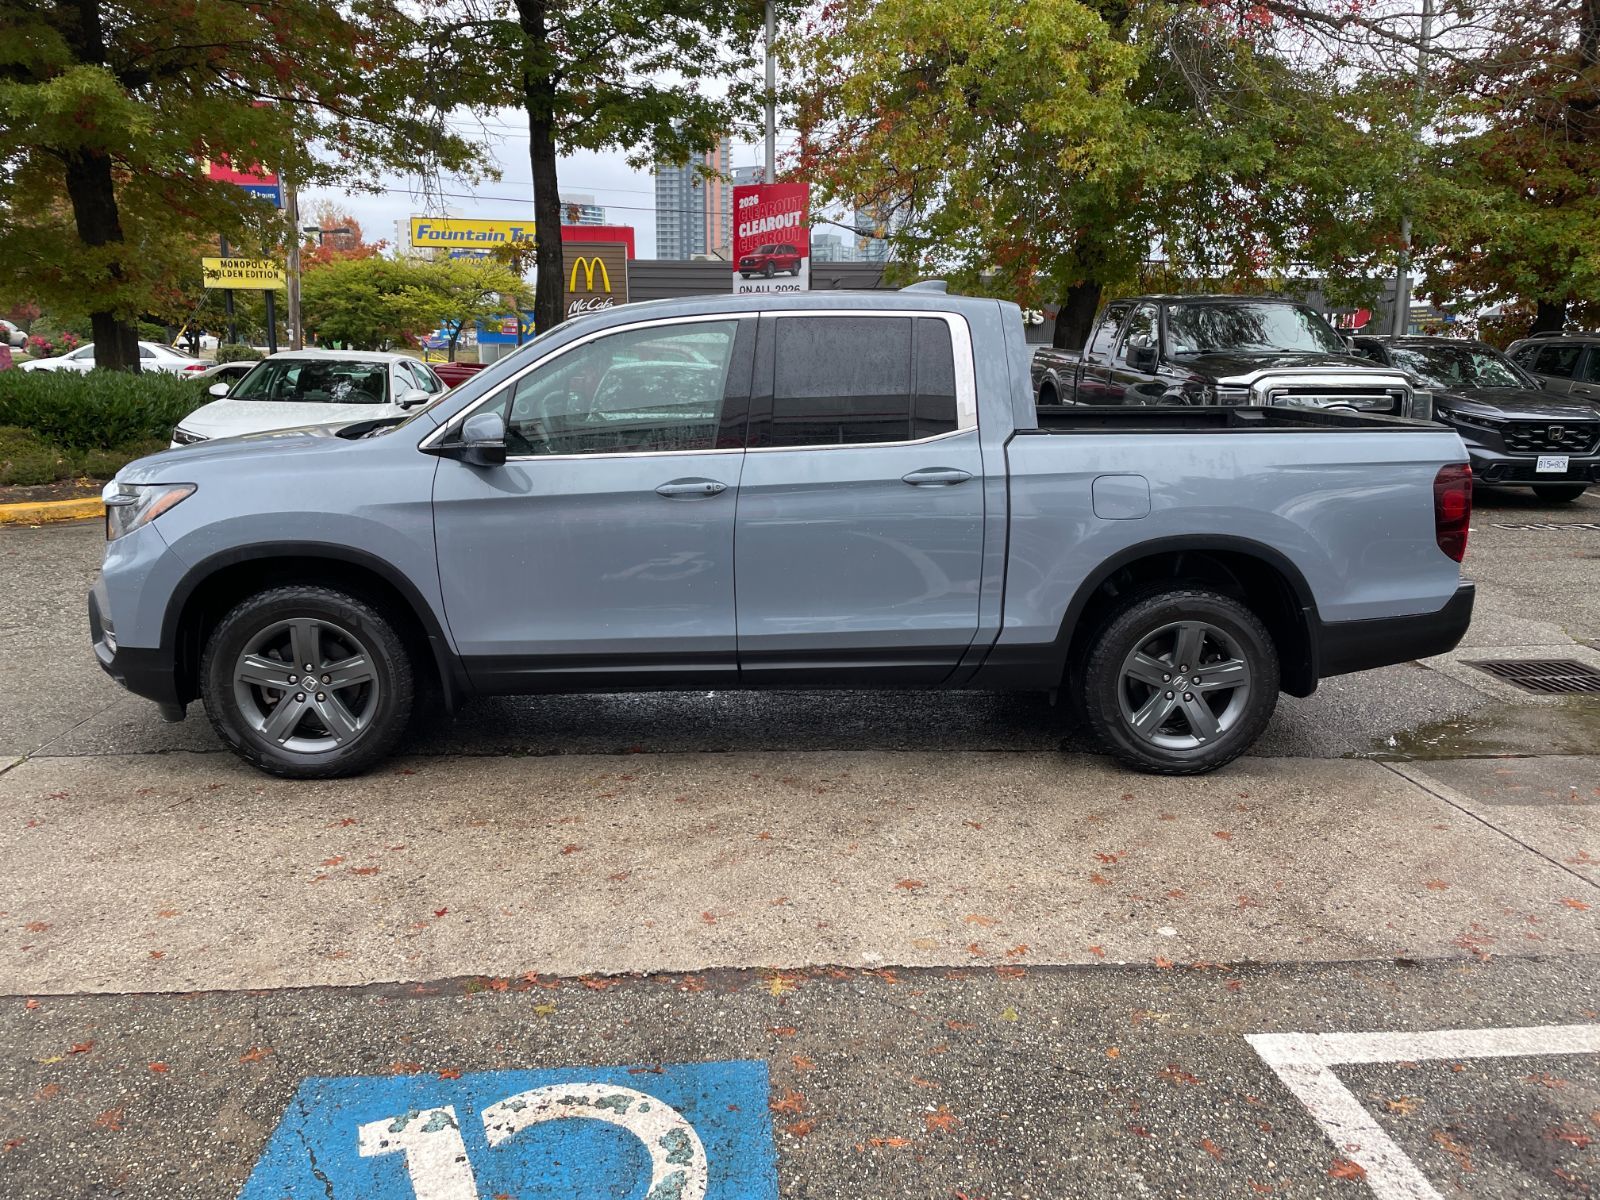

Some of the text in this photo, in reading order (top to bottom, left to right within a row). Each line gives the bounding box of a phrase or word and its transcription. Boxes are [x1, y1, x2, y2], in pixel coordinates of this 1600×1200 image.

[739, 195, 759, 208] 2026
[739, 196, 802, 223] CLEAROUT
[739, 211, 802, 238] CLEAROUT
[417, 224, 505, 242] Fountain
[739, 227, 802, 253] CLEAROUT
[220, 260, 269, 270] MONOPOLY
[210, 269, 279, 279] OLDEN EDITION
[740, 285, 753, 293] ON
[754, 285, 770, 293] ALL
